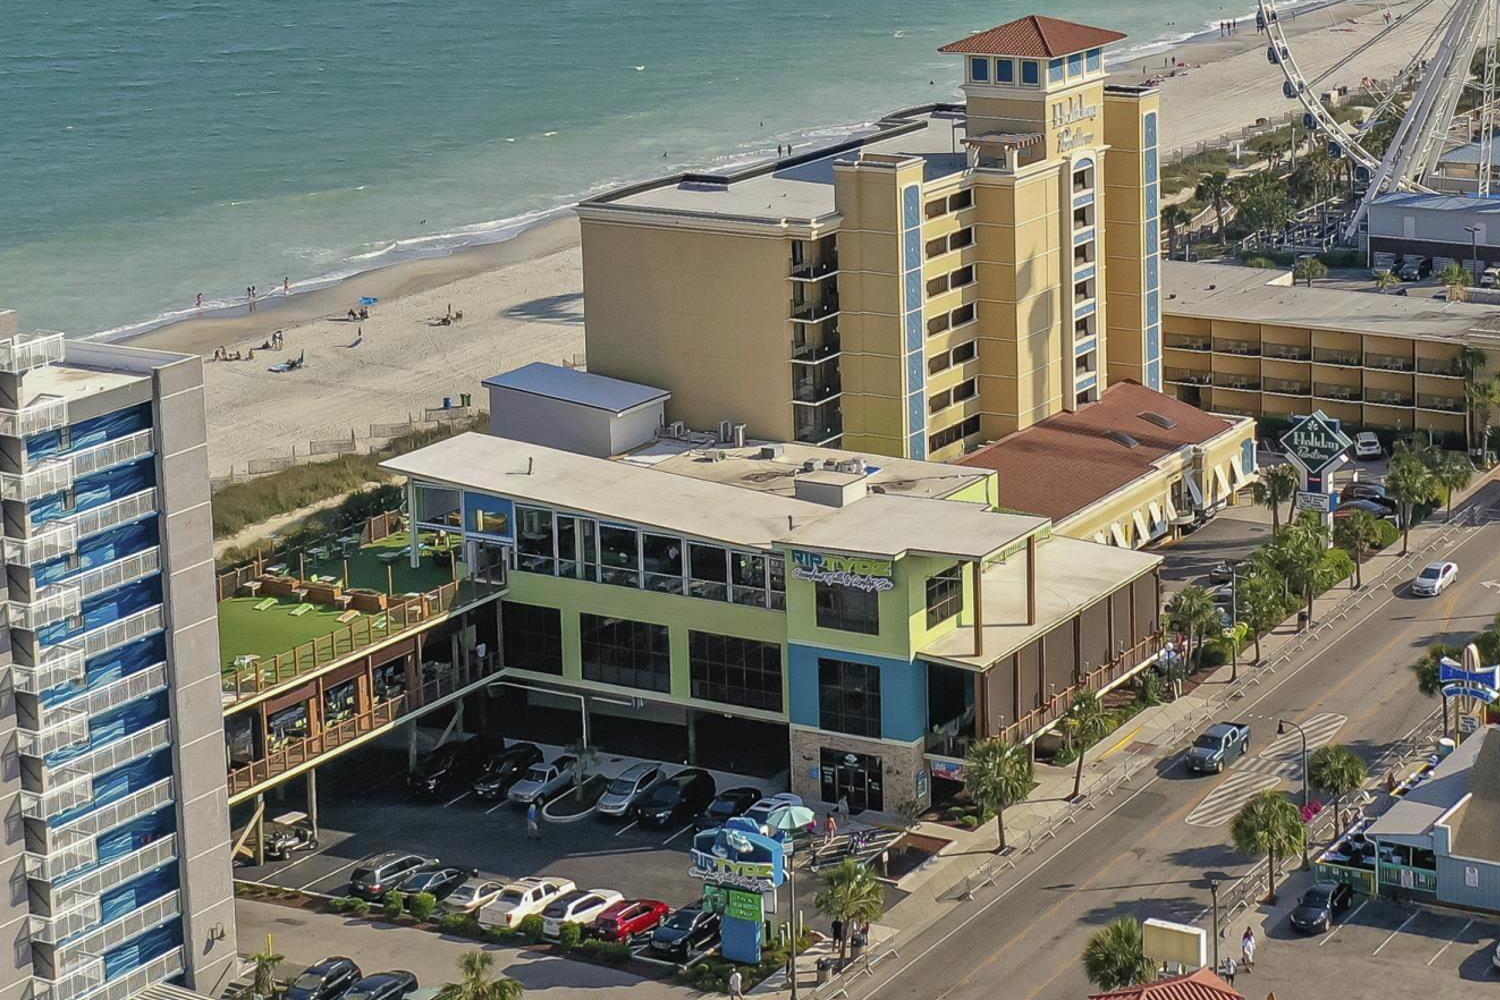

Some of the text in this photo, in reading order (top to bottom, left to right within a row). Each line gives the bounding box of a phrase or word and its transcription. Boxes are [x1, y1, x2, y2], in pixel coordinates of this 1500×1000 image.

[1052, 93, 1097, 130] Holiday
[1293, 431, 1339, 451] Holiday
[1298, 446, 1329, 460] Pavilion
